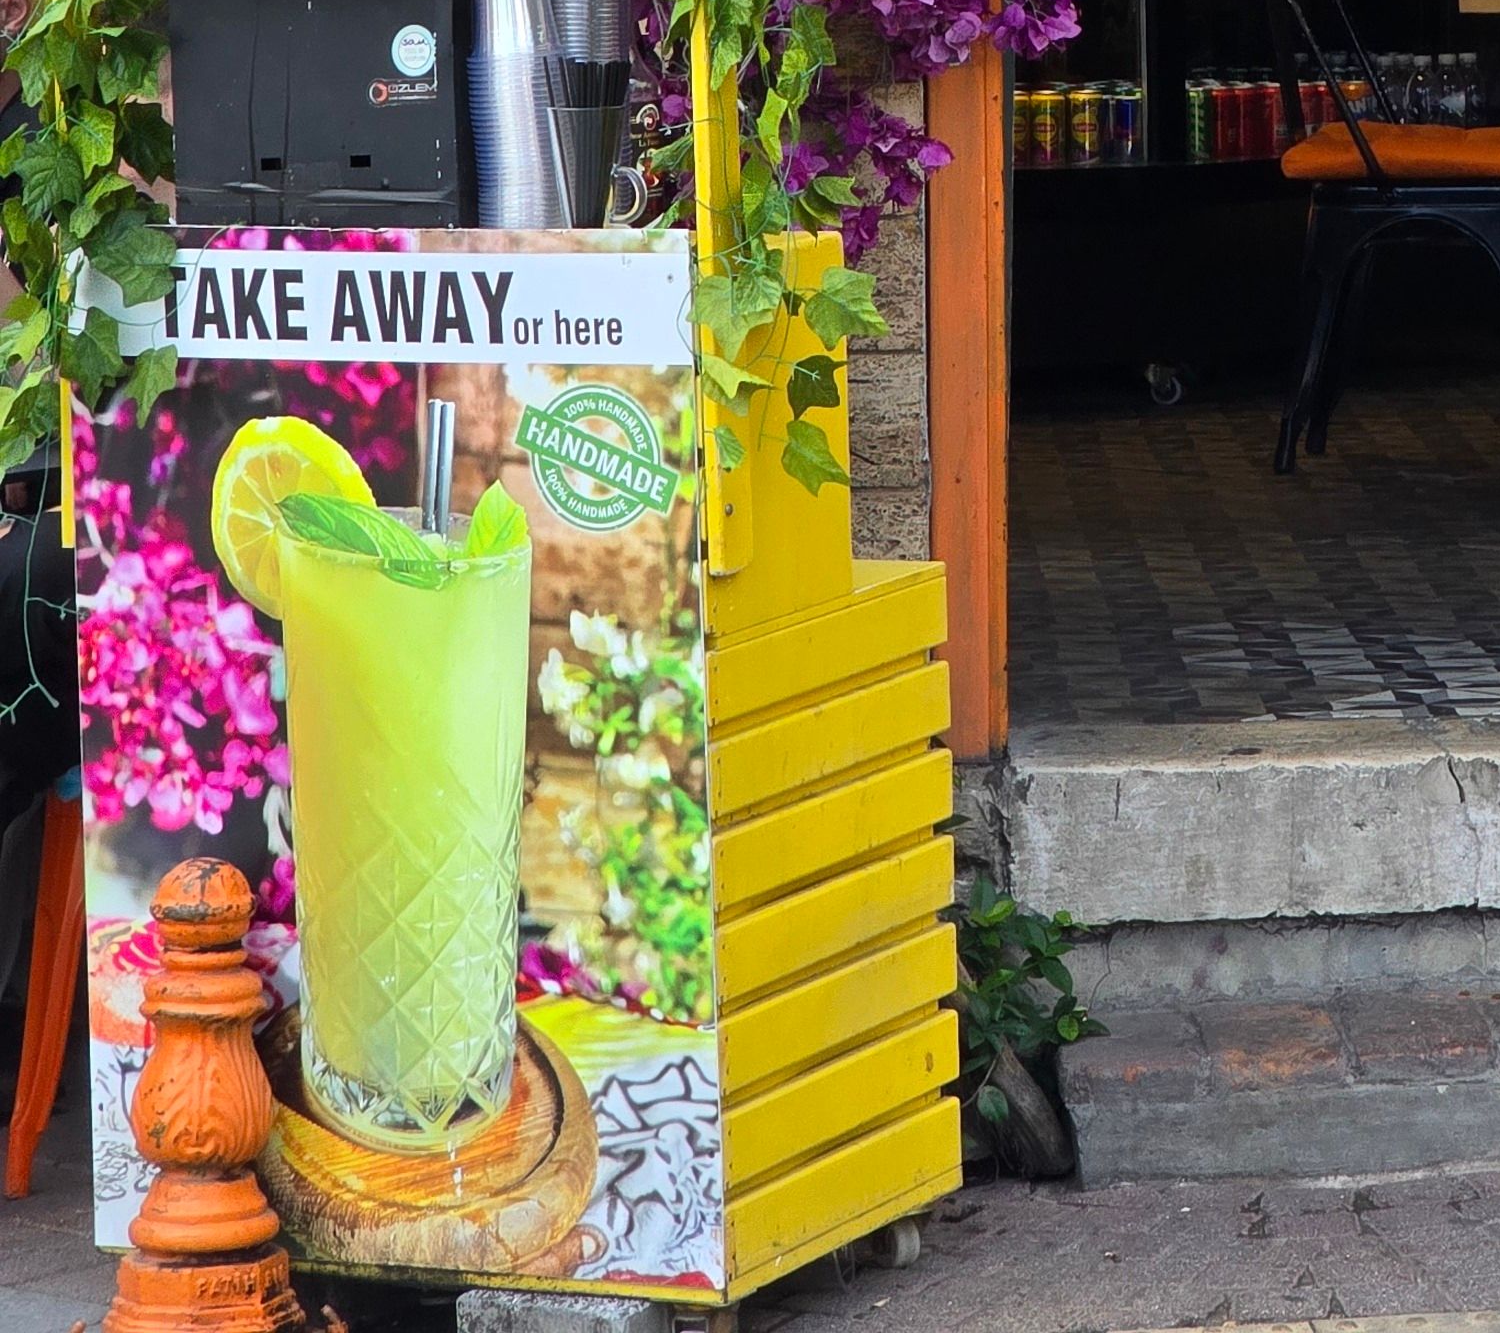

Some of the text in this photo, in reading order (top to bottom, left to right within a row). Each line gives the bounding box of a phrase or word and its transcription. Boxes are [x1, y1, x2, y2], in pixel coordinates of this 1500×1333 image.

[163, 267, 624, 346] TAKE AWAY or here
[564, 398, 648, 453] 100% HANDMADE
[526, 416, 669, 504] HANDMADE
[546, 467, 629, 518] 100% HANDMADE
